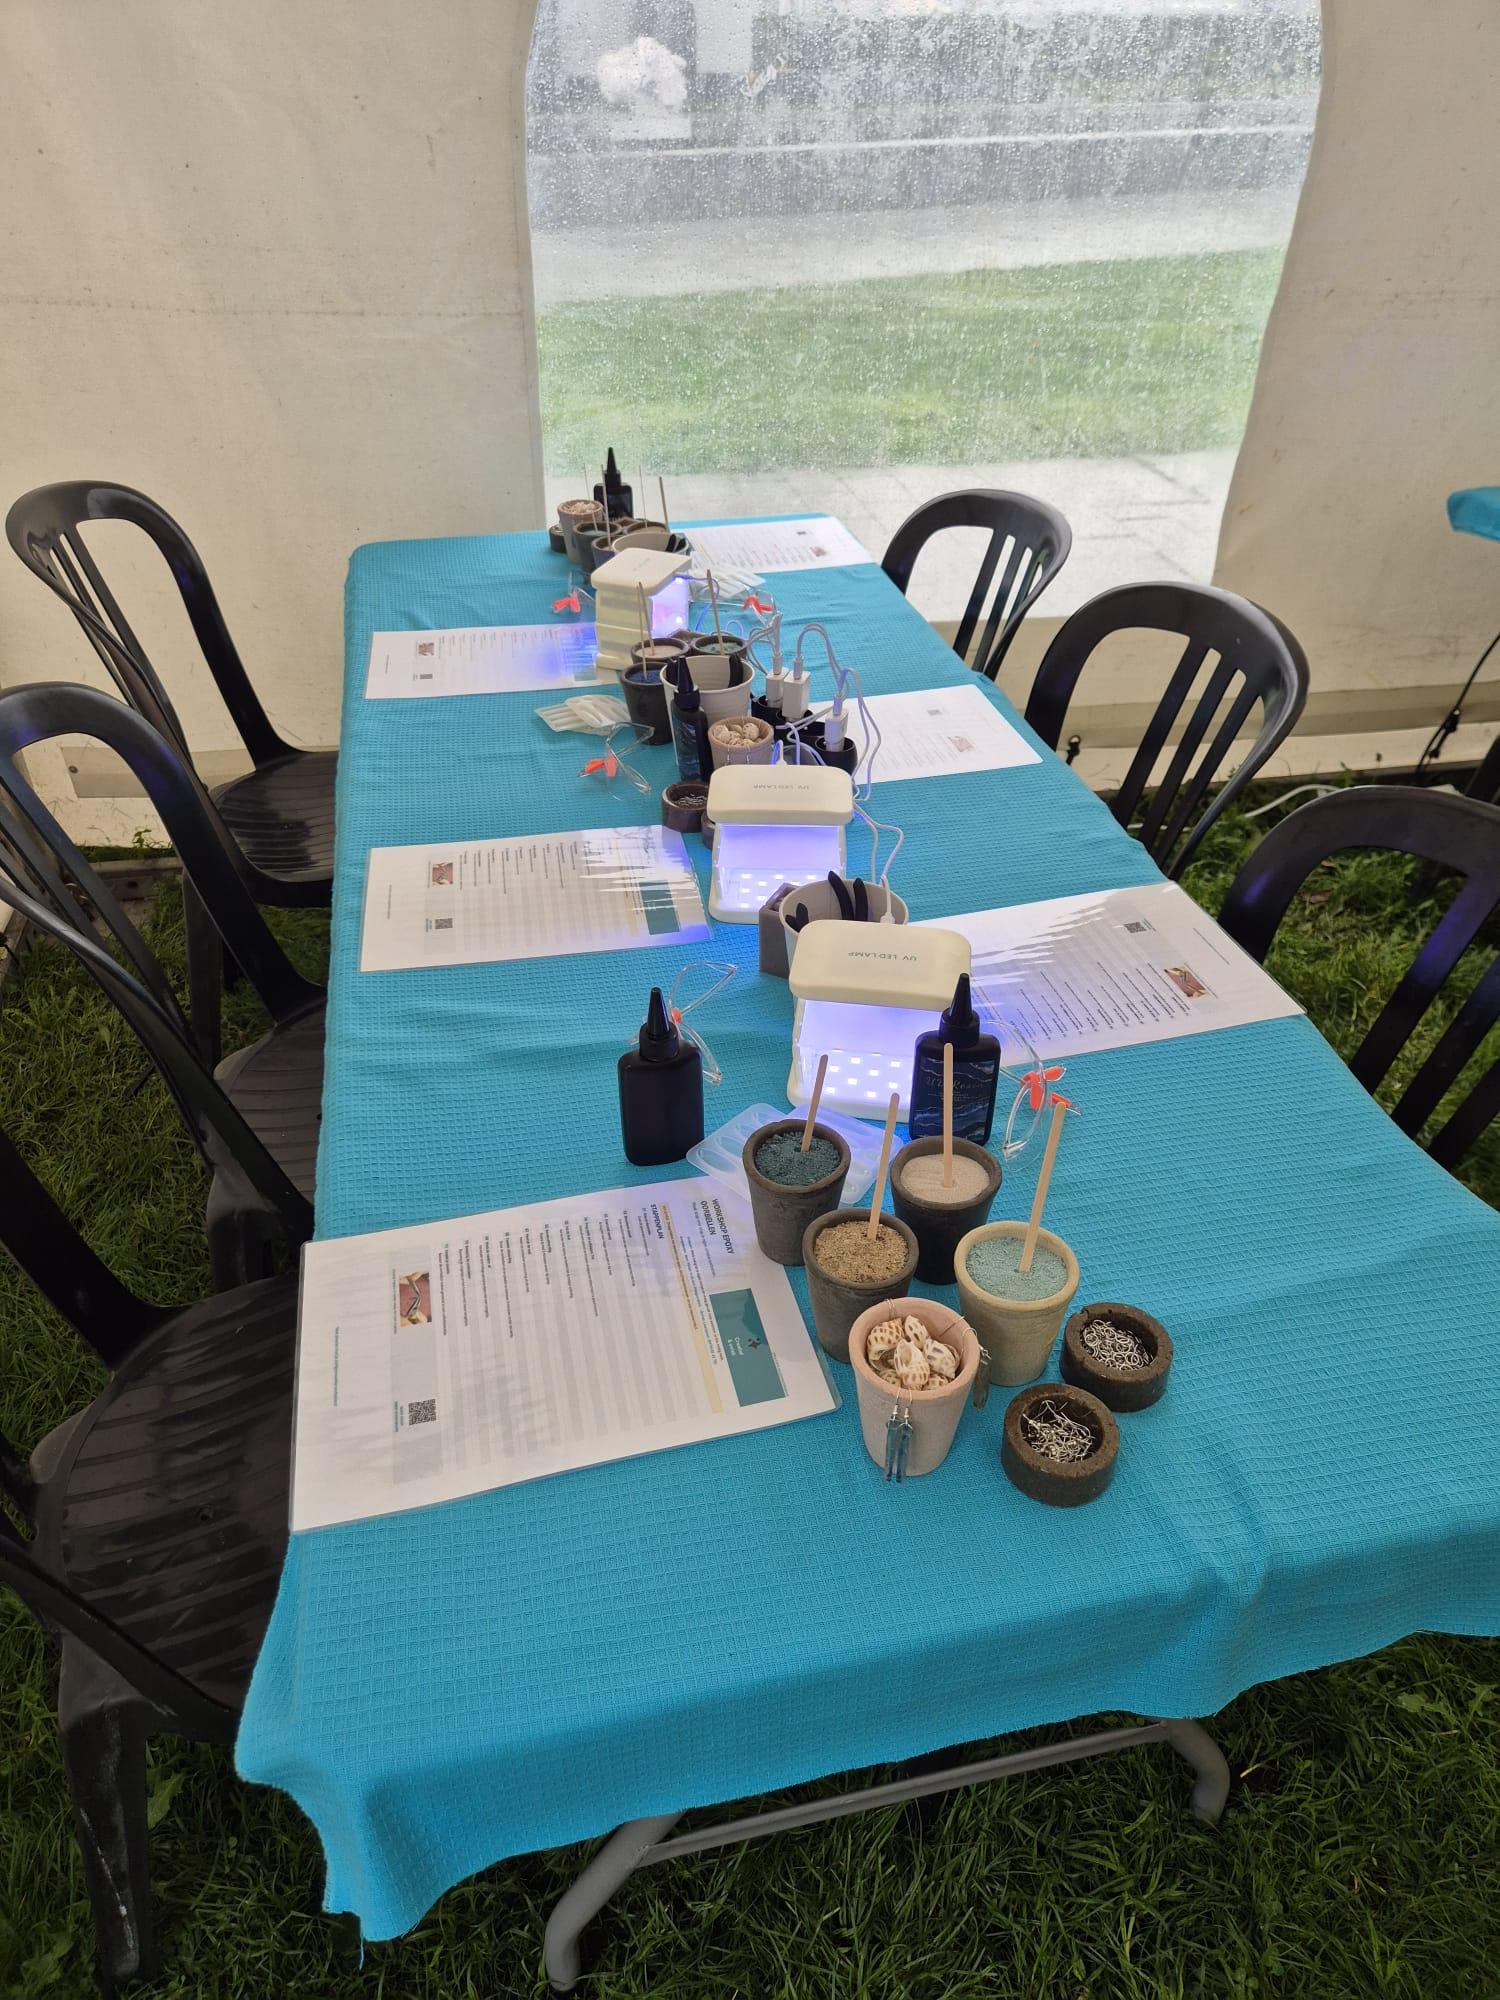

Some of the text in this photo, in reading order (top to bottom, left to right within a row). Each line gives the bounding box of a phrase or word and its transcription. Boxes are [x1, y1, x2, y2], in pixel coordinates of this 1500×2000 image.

[848, 950, 876, 958] LAMP
[878, 952, 897, 960] LED
[650, 1203, 665, 1239] STAPPENPLAN
[700, 1200, 717, 1236] OORBELLEN
[712, 1198, 735, 1255] WORKSHOP EPOXY
